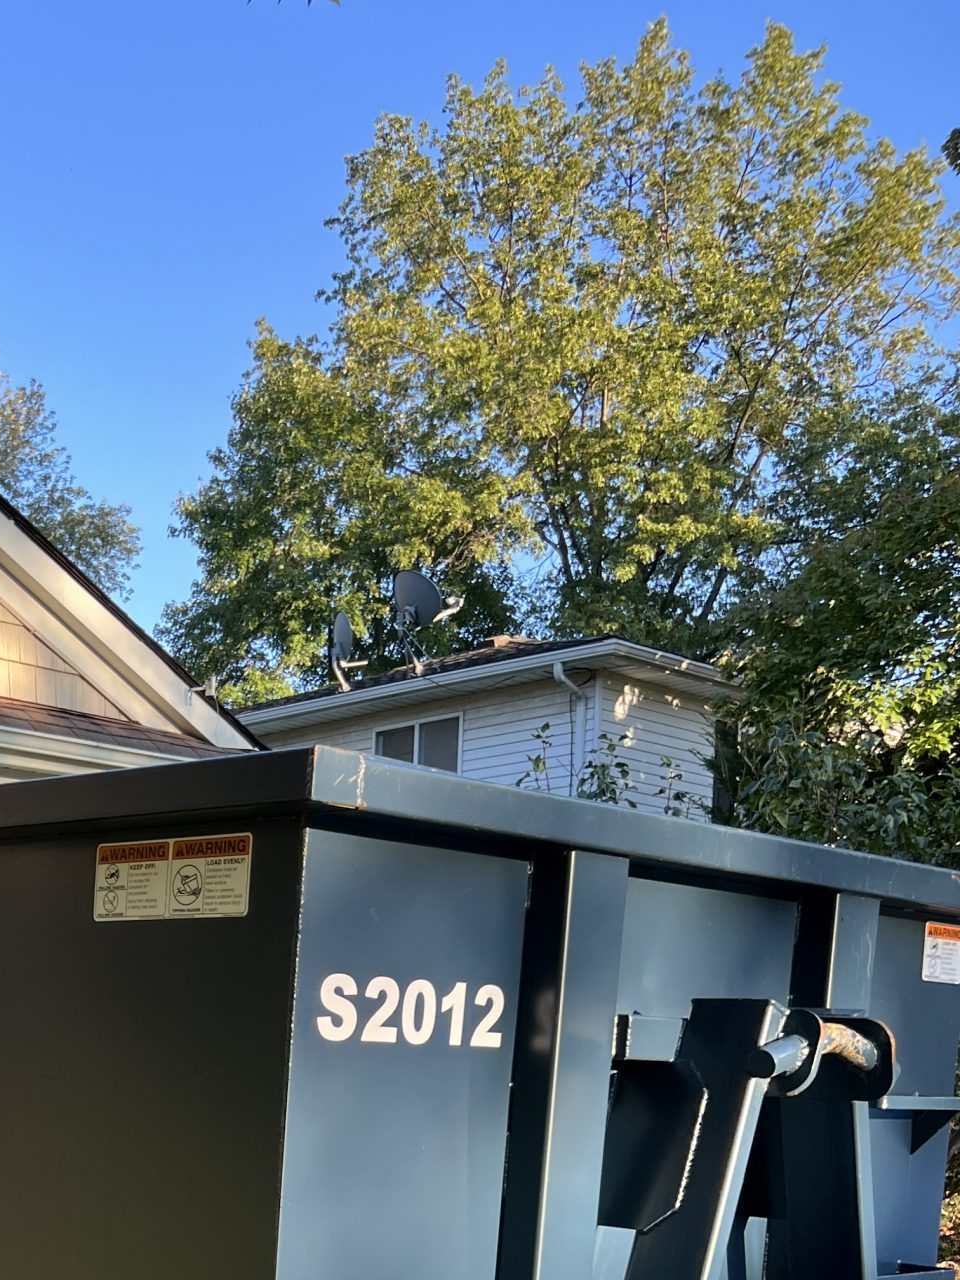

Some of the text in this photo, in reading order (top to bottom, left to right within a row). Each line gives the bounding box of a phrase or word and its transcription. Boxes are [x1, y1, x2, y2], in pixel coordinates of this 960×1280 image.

[109, 844, 166, 861] WARNING
[184, 839, 247, 856] WARNING
[316, 973, 505, 1048] S2012
